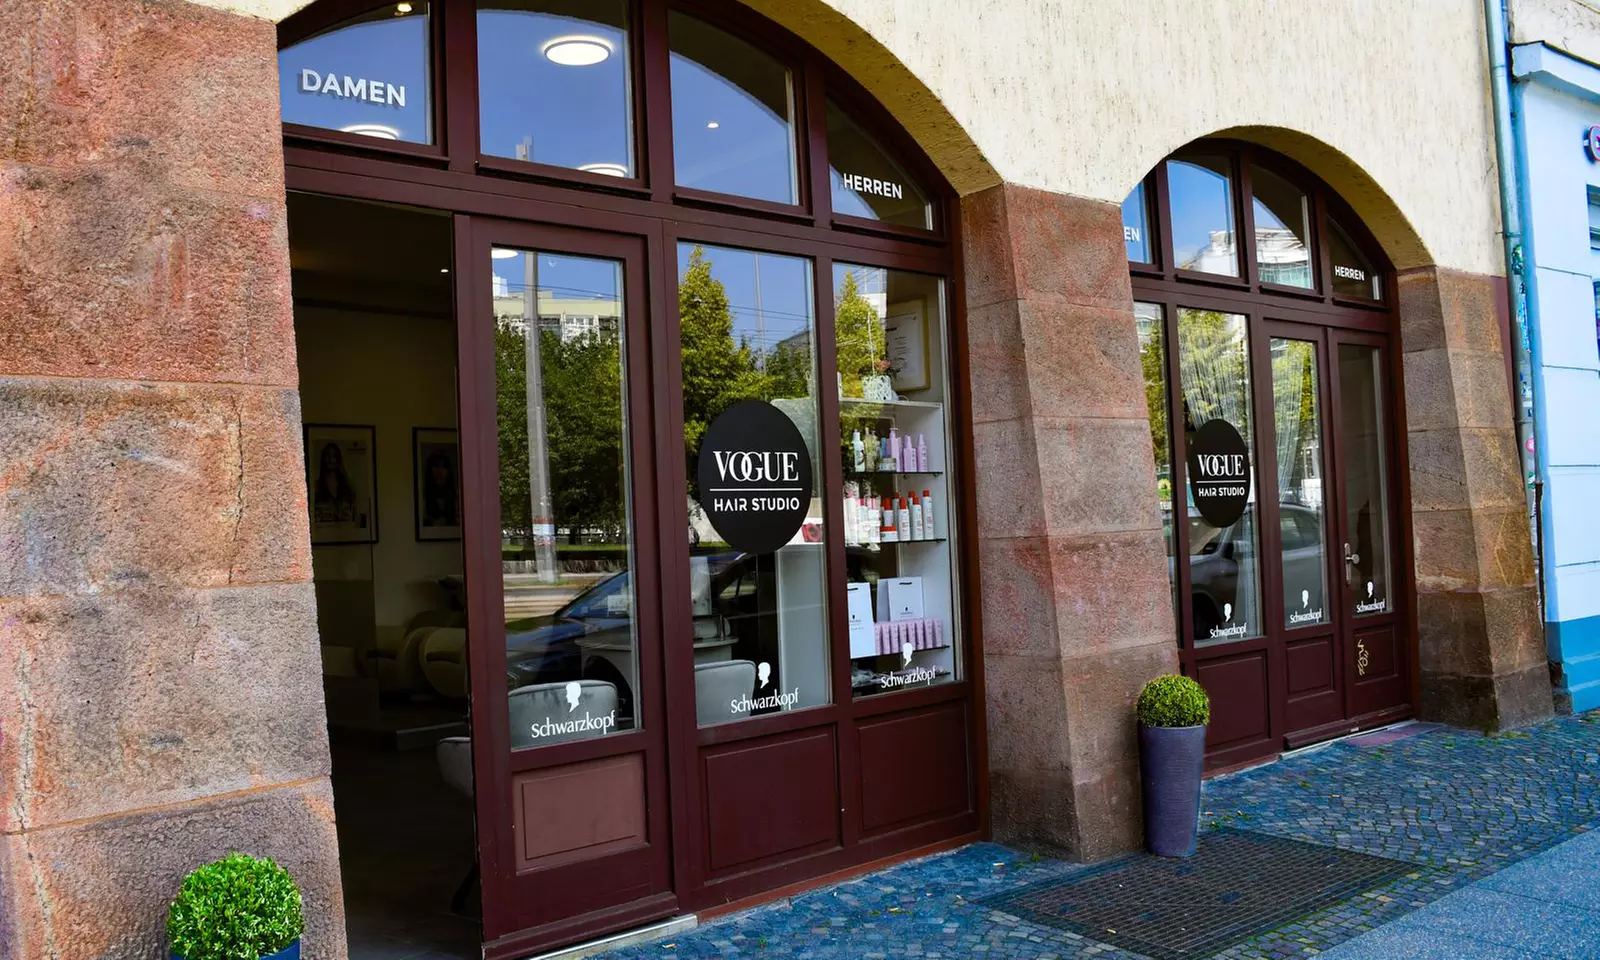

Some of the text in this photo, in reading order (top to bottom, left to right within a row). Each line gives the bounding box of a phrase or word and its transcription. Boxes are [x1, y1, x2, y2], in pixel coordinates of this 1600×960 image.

[302, 69, 405, 107] DAMEN
[842, 173, 904, 200] HERREN
[1334, 265, 1365, 282] HERREN
[712, 450, 799, 482] VOGUE
[1197, 454, 1245, 477] VOGUE
[1198, 486, 1246, 497] HAIR STUDIO
[714, 497, 800, 512] HAIR STUDIO
[1209, 622, 1247, 639] Schwarzkopf
[880, 665, 937, 689] Schwarzkopf
[731, 687, 799, 714] Schwarzkopf
[531, 709, 616, 739] Schwarzkopf
